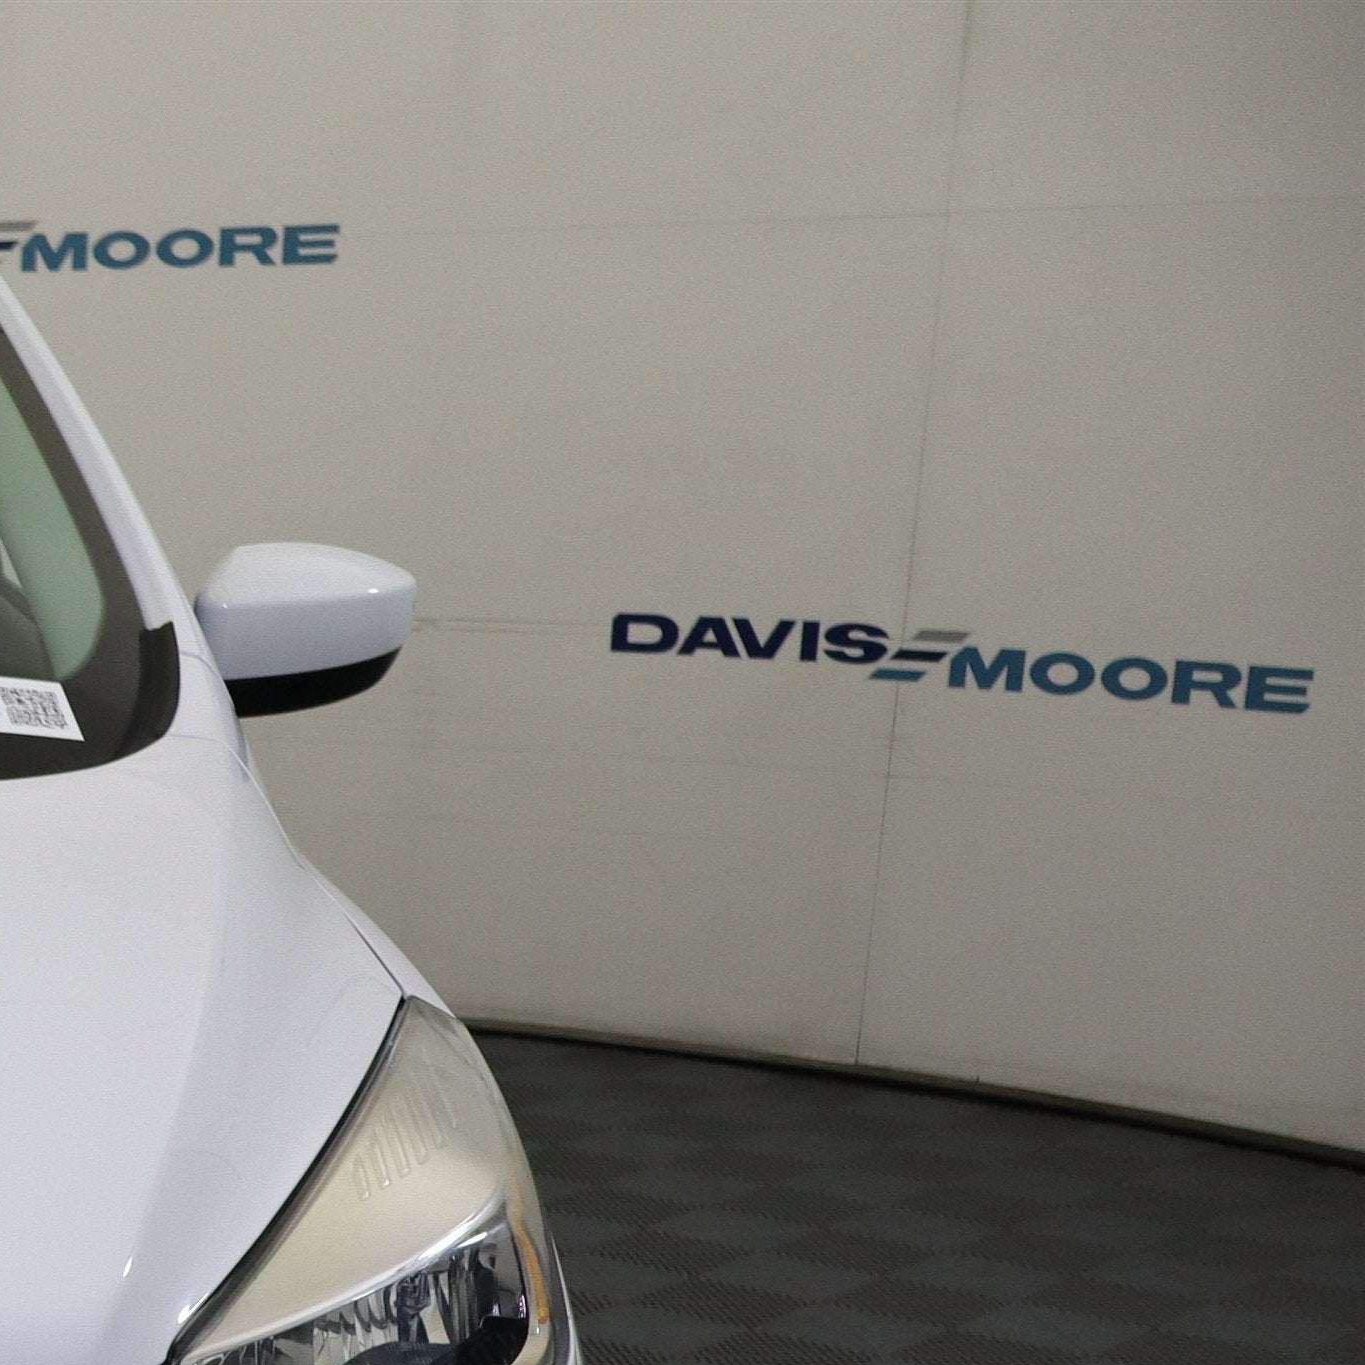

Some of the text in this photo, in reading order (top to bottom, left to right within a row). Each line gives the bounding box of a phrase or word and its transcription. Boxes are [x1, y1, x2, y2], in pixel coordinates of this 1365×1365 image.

[20, 223, 341, 273] MOORE
[609, 612, 1315, 714] DAVIS MOORE
